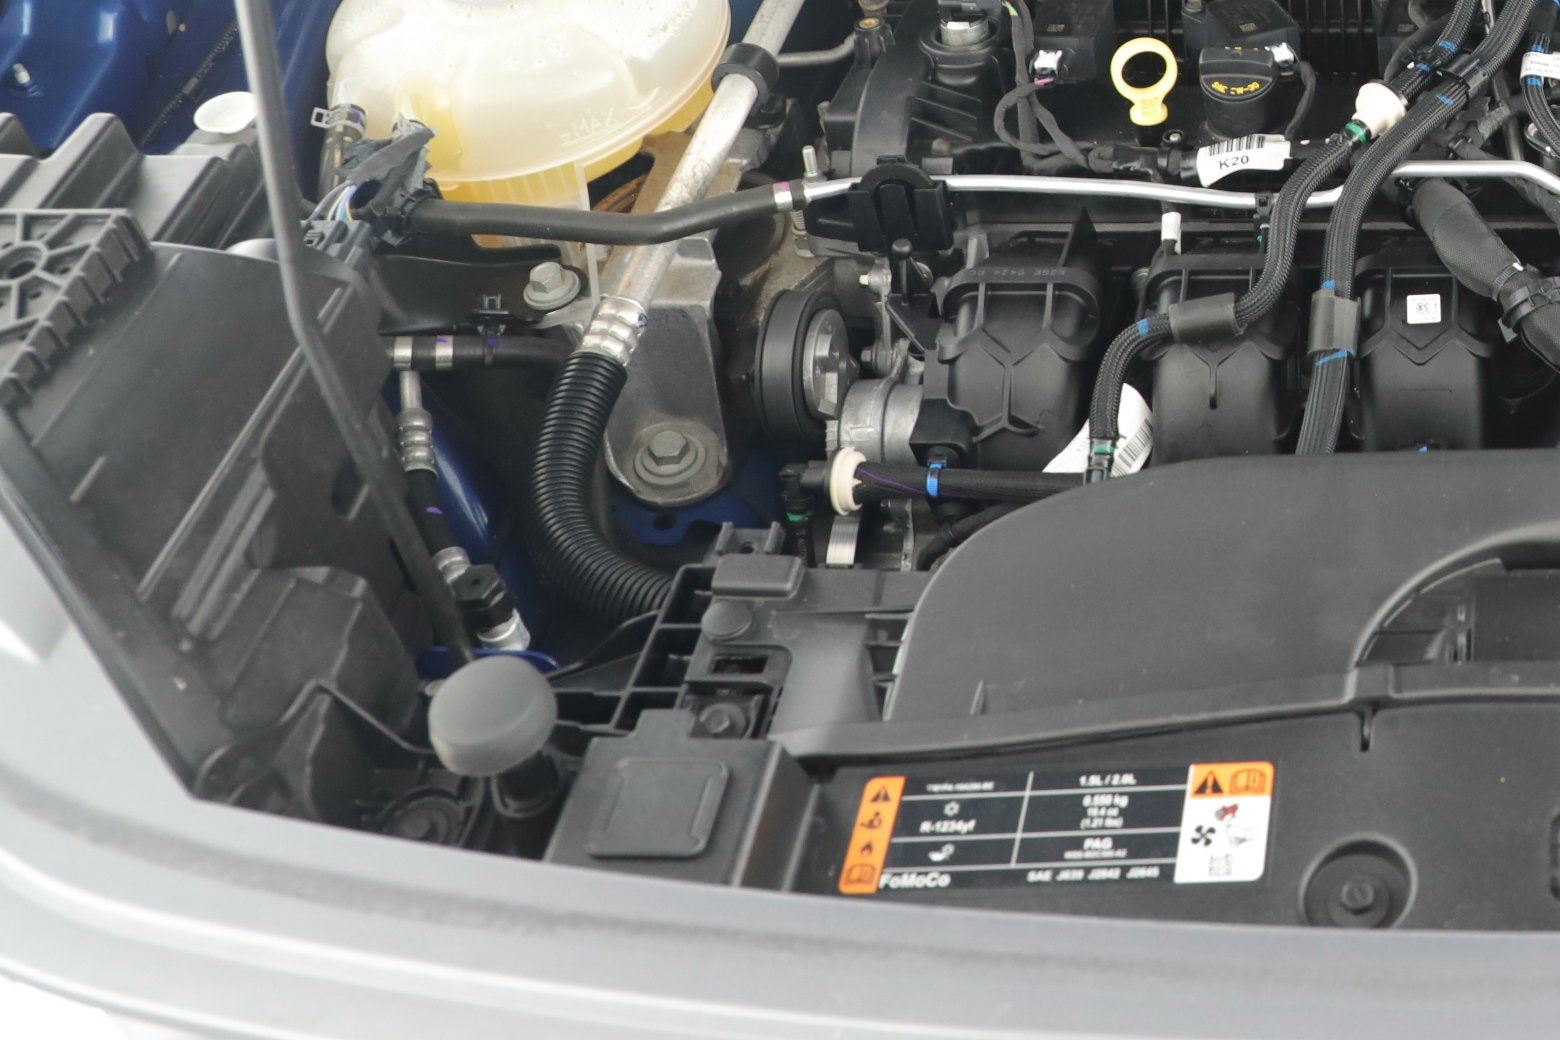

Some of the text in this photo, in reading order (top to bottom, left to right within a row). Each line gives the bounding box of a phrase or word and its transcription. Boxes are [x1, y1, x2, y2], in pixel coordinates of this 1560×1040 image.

[1211, 81, 1228, 94] SAE
[1219, 155, 1250, 171] K20
[919, 818, 977, 834] R-1234yf
[878, 871, 952, 889] FoMoCo
[1027, 869, 1053, 882] SAE
